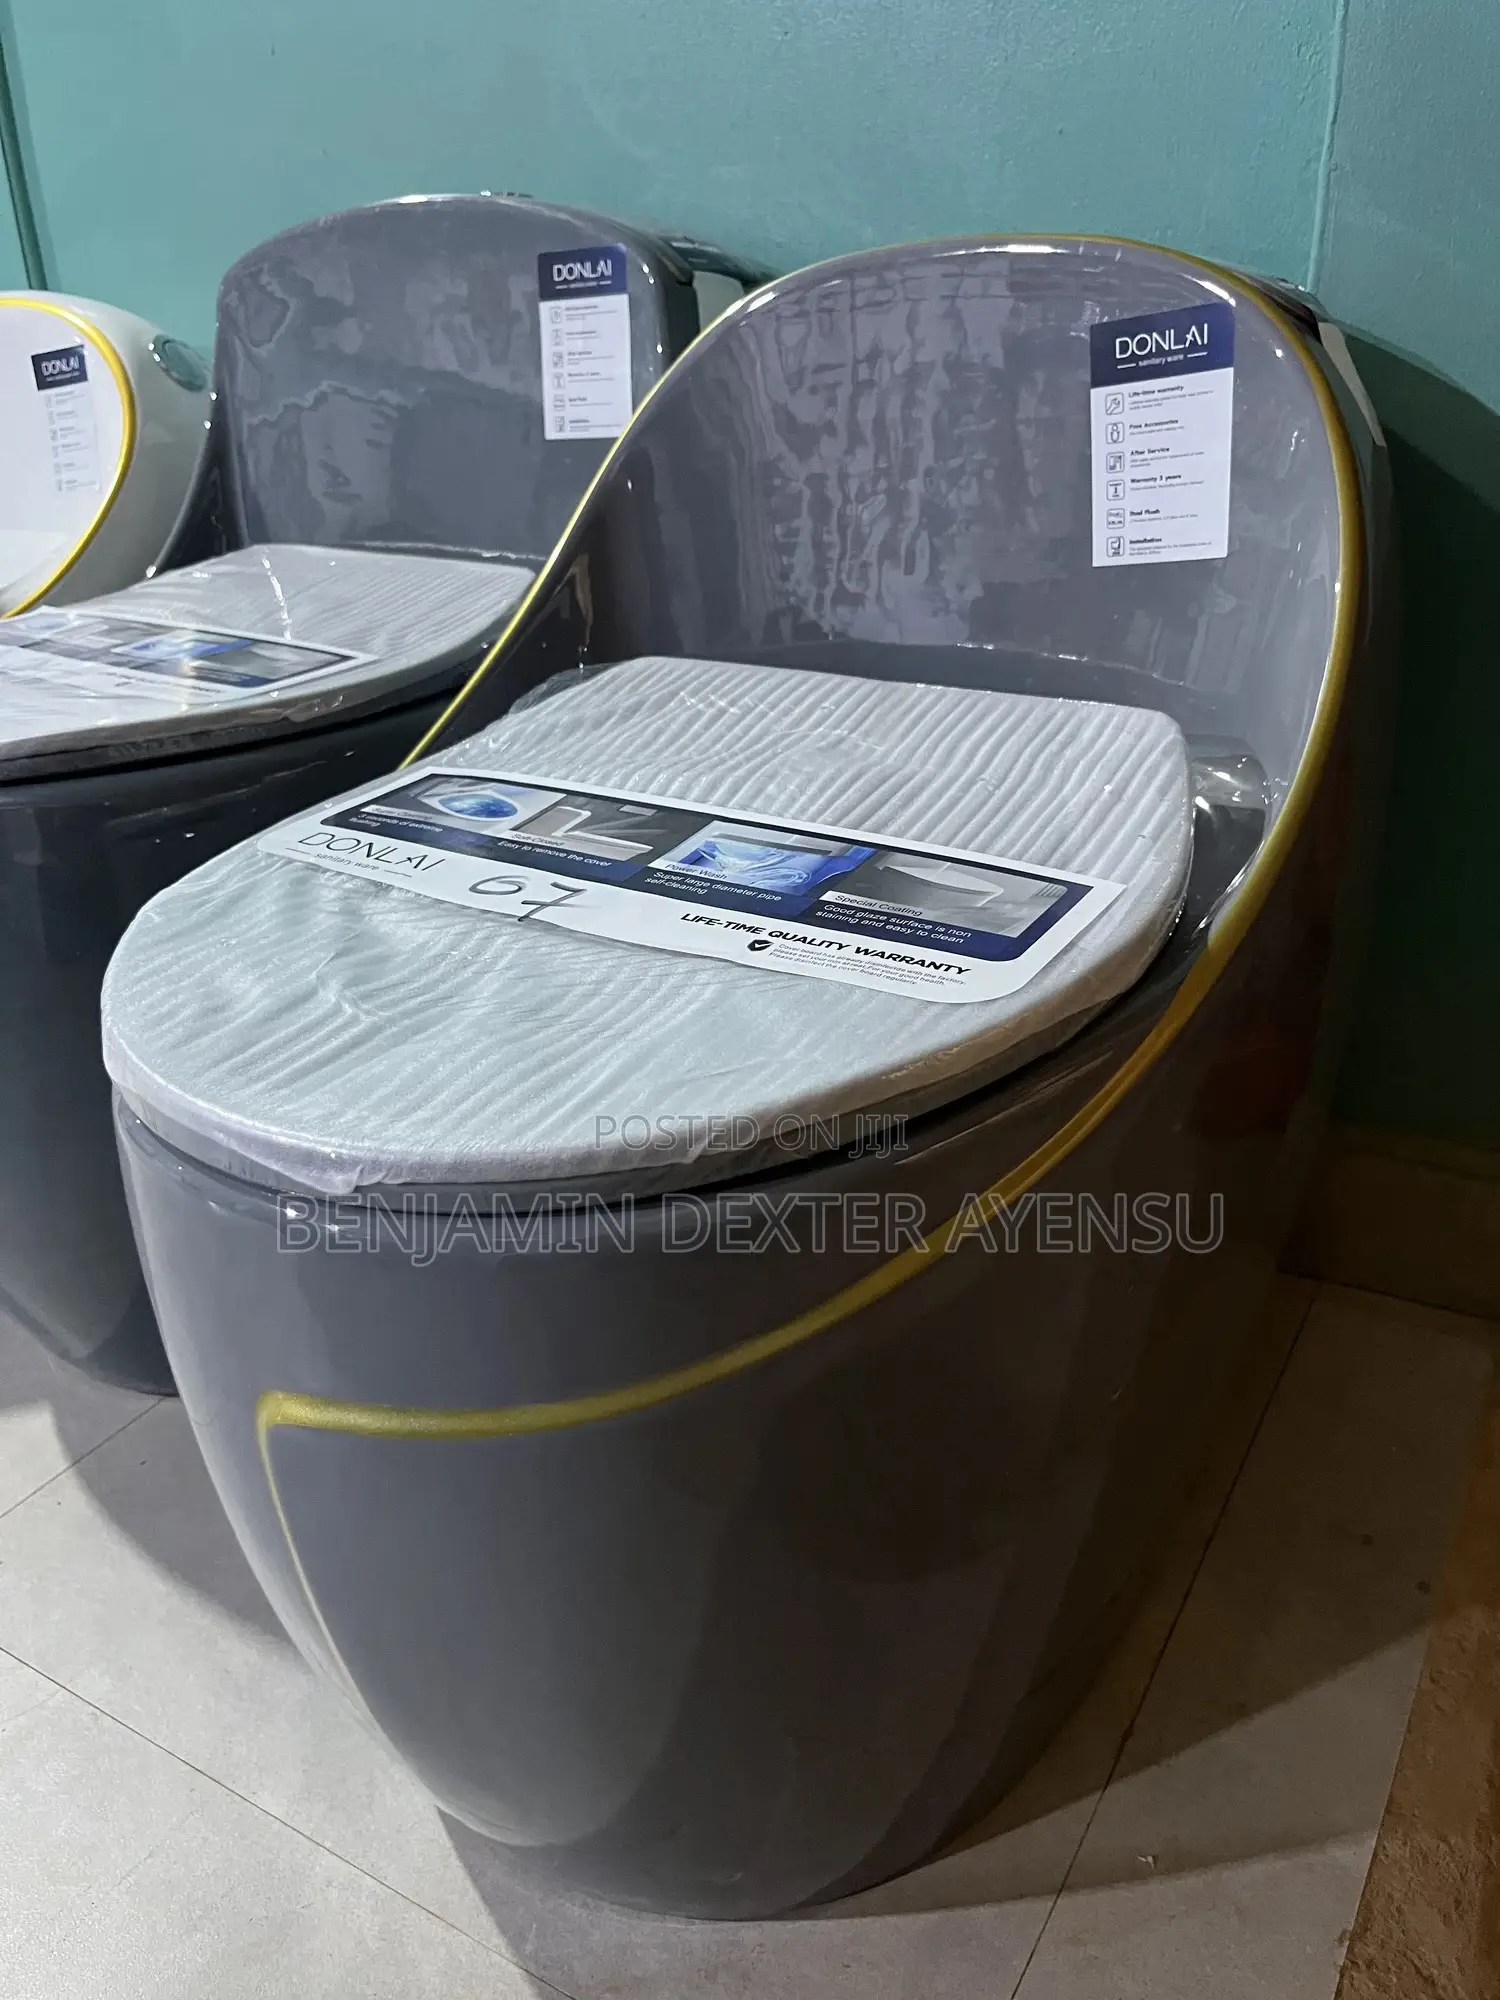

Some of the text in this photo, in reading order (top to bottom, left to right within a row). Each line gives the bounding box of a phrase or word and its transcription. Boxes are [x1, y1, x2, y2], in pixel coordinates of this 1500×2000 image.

[552, 259, 612, 282] DONLAI
[1115, 323, 1208, 359] DONLAI
[298, 832, 446, 871] DONLAI
[315, 853, 380, 871] sanitary ware
[498, 840, 522, 850] Easy
[532, 848, 567, 858] remove
[567, 853, 584, 861] the
[584, 858, 613, 867] cover
[664, 863, 728, 880] Power Wash
[644, 877, 708, 895] self-cleaning
[653, 871, 782, 902] Super large diameter pipe
[835, 894, 923, 917] Special Coating
[815, 910, 964, 944] staining and easy to clean
[824, 904, 856, 916] Good
[855, 910, 888, 921] glaze
[889, 915, 933, 930] surface
[948, 929, 972, 938] non
[680, 913, 972, 975] LIFE-TIME QUALITY WARRANTY
[779, 943, 800, 952] Cover
[800, 948, 822, 956] board
[836, 955, 864, 964] already
[769, 952, 793, 961] Please
[794, 957, 825, 967] disinfect
[859, 969, 884, 978] board
